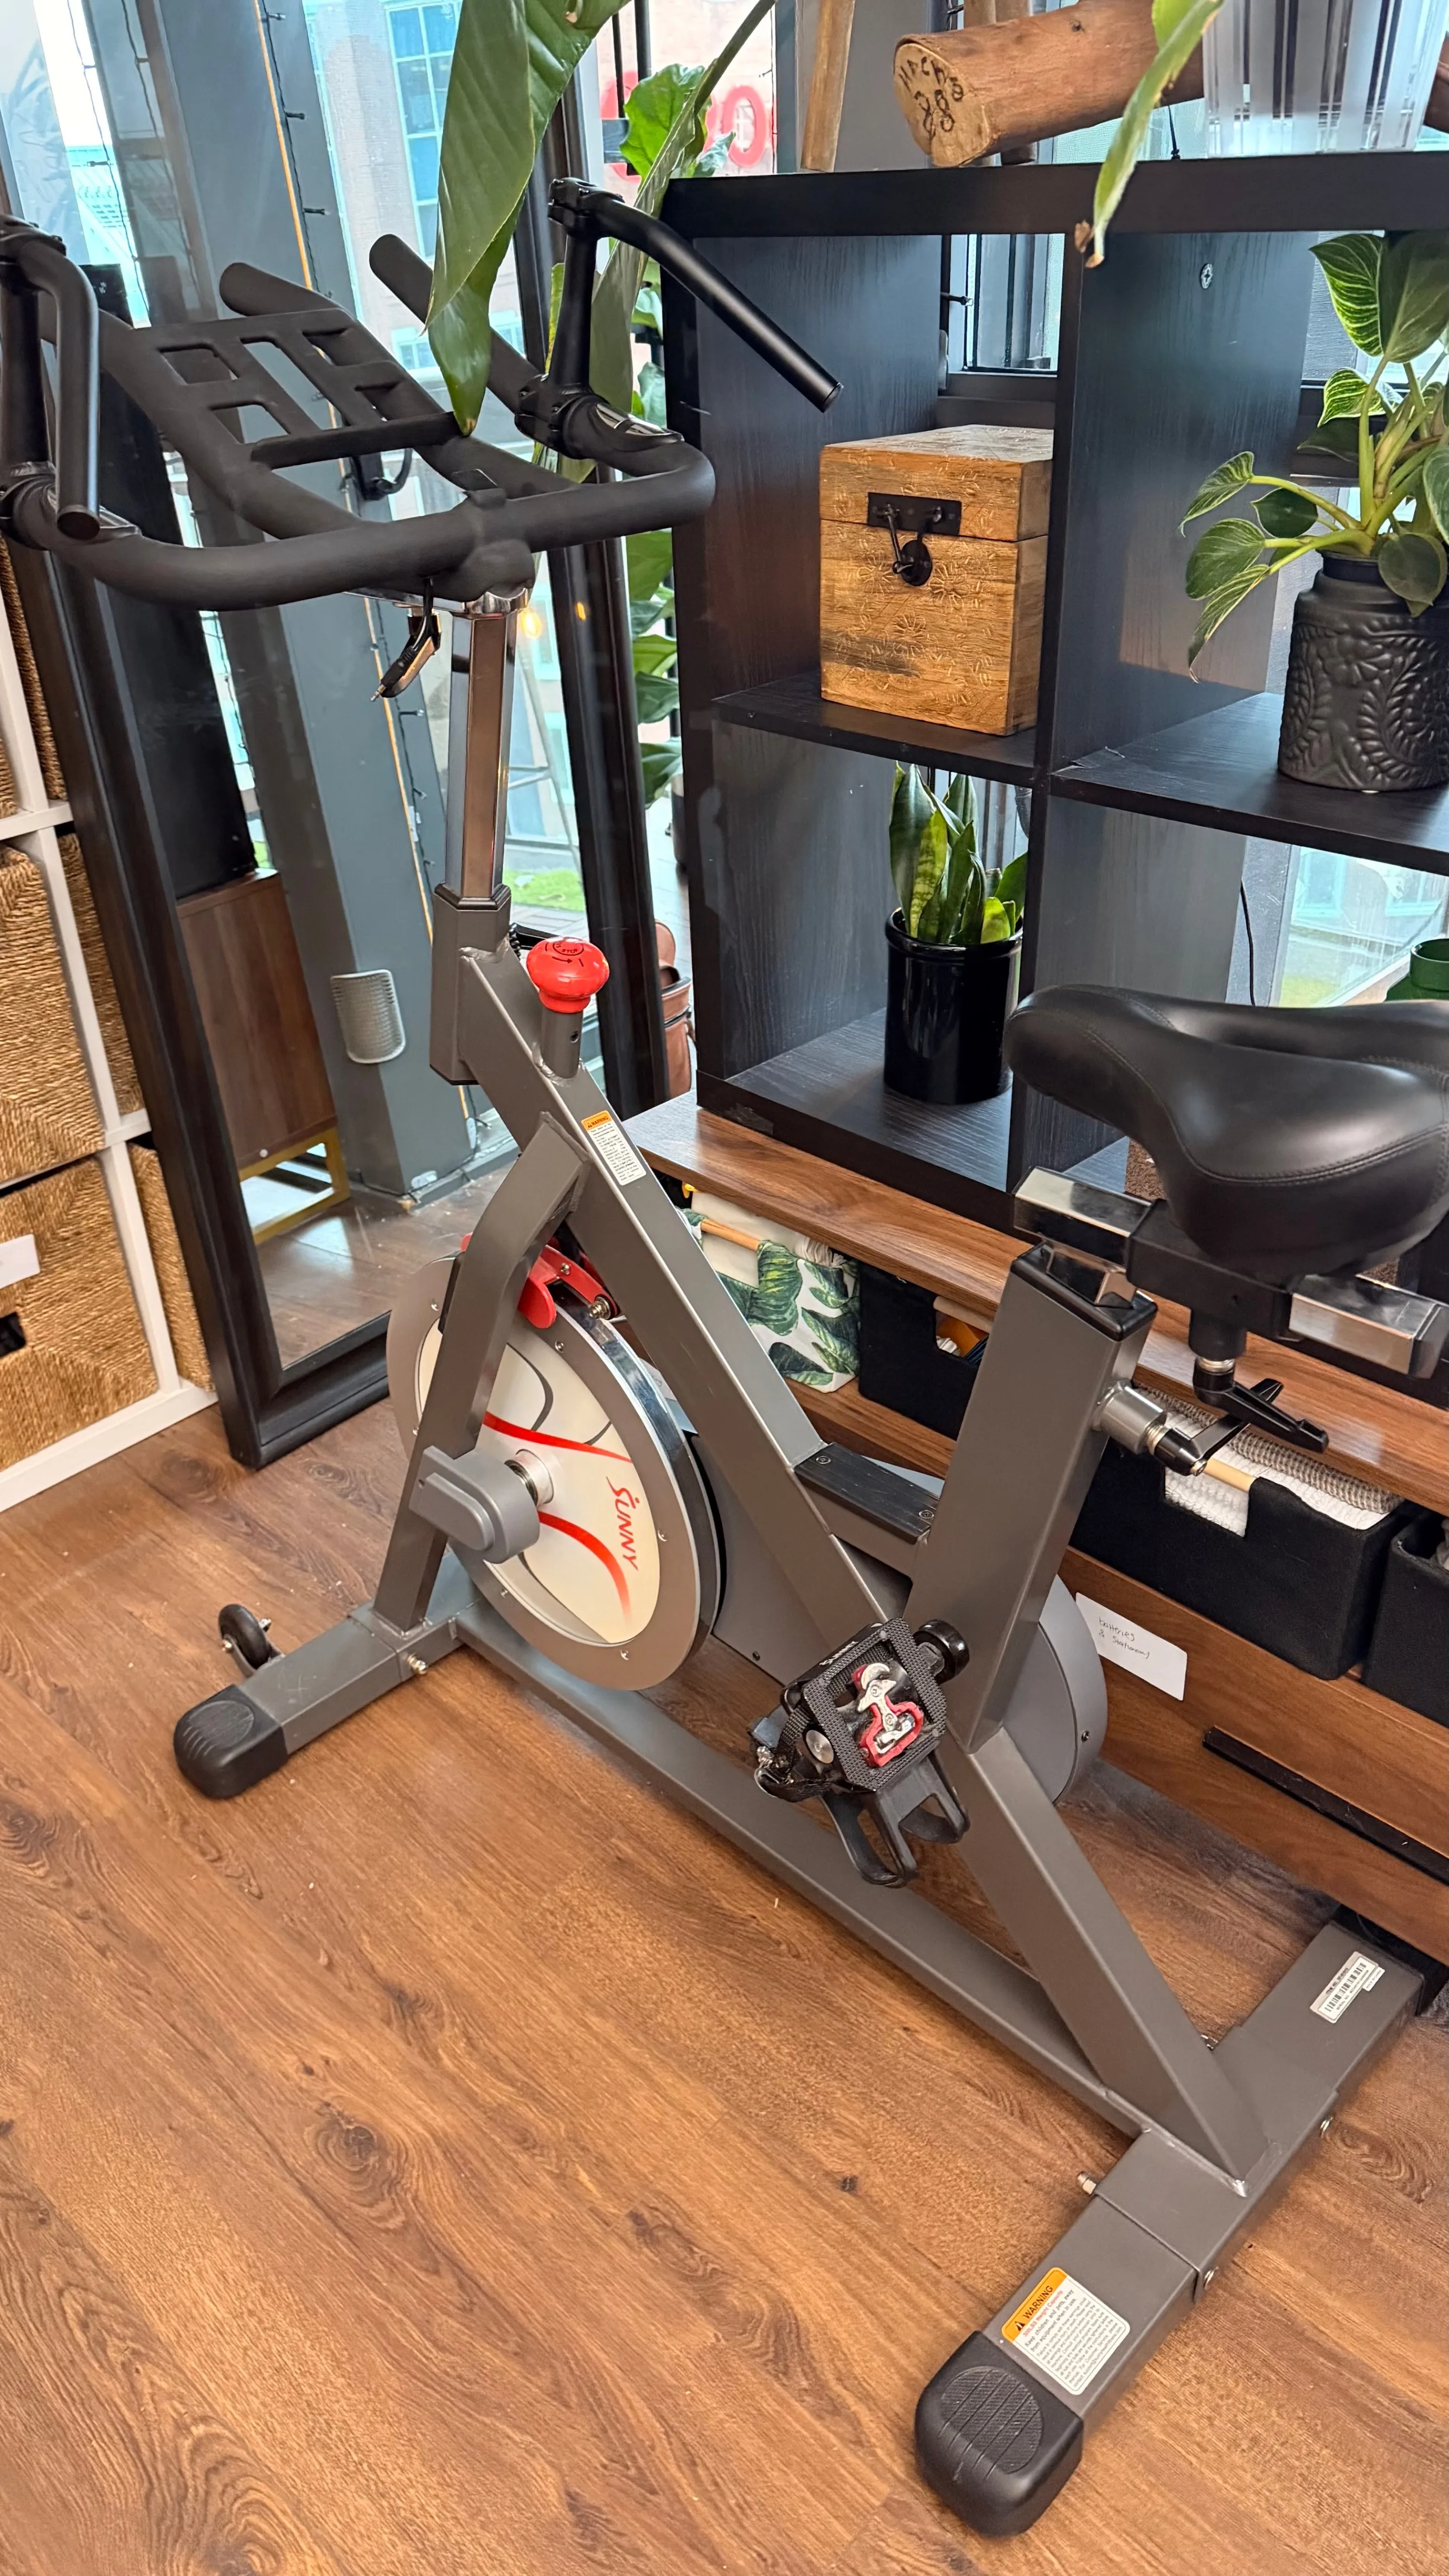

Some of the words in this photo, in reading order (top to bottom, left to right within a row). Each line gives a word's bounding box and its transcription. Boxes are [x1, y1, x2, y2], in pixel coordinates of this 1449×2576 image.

[606, 1476, 640, 1571] SUNNY
[1022, 2284, 1054, 2319] WARNING
[1024, 2335, 1035, 2347] Keep
[1034, 2318, 1049, 2335] children
[1048, 2309, 1057, 2318] and
[1063, 2289, 1074, 2301] away
[1047, 2289, 1063, 2308] Capacity
[1030, 2341, 1040, 2352] from
[1038, 2319, 1059, 2343] equipment
[1055, 2309, 1066, 2322] when
